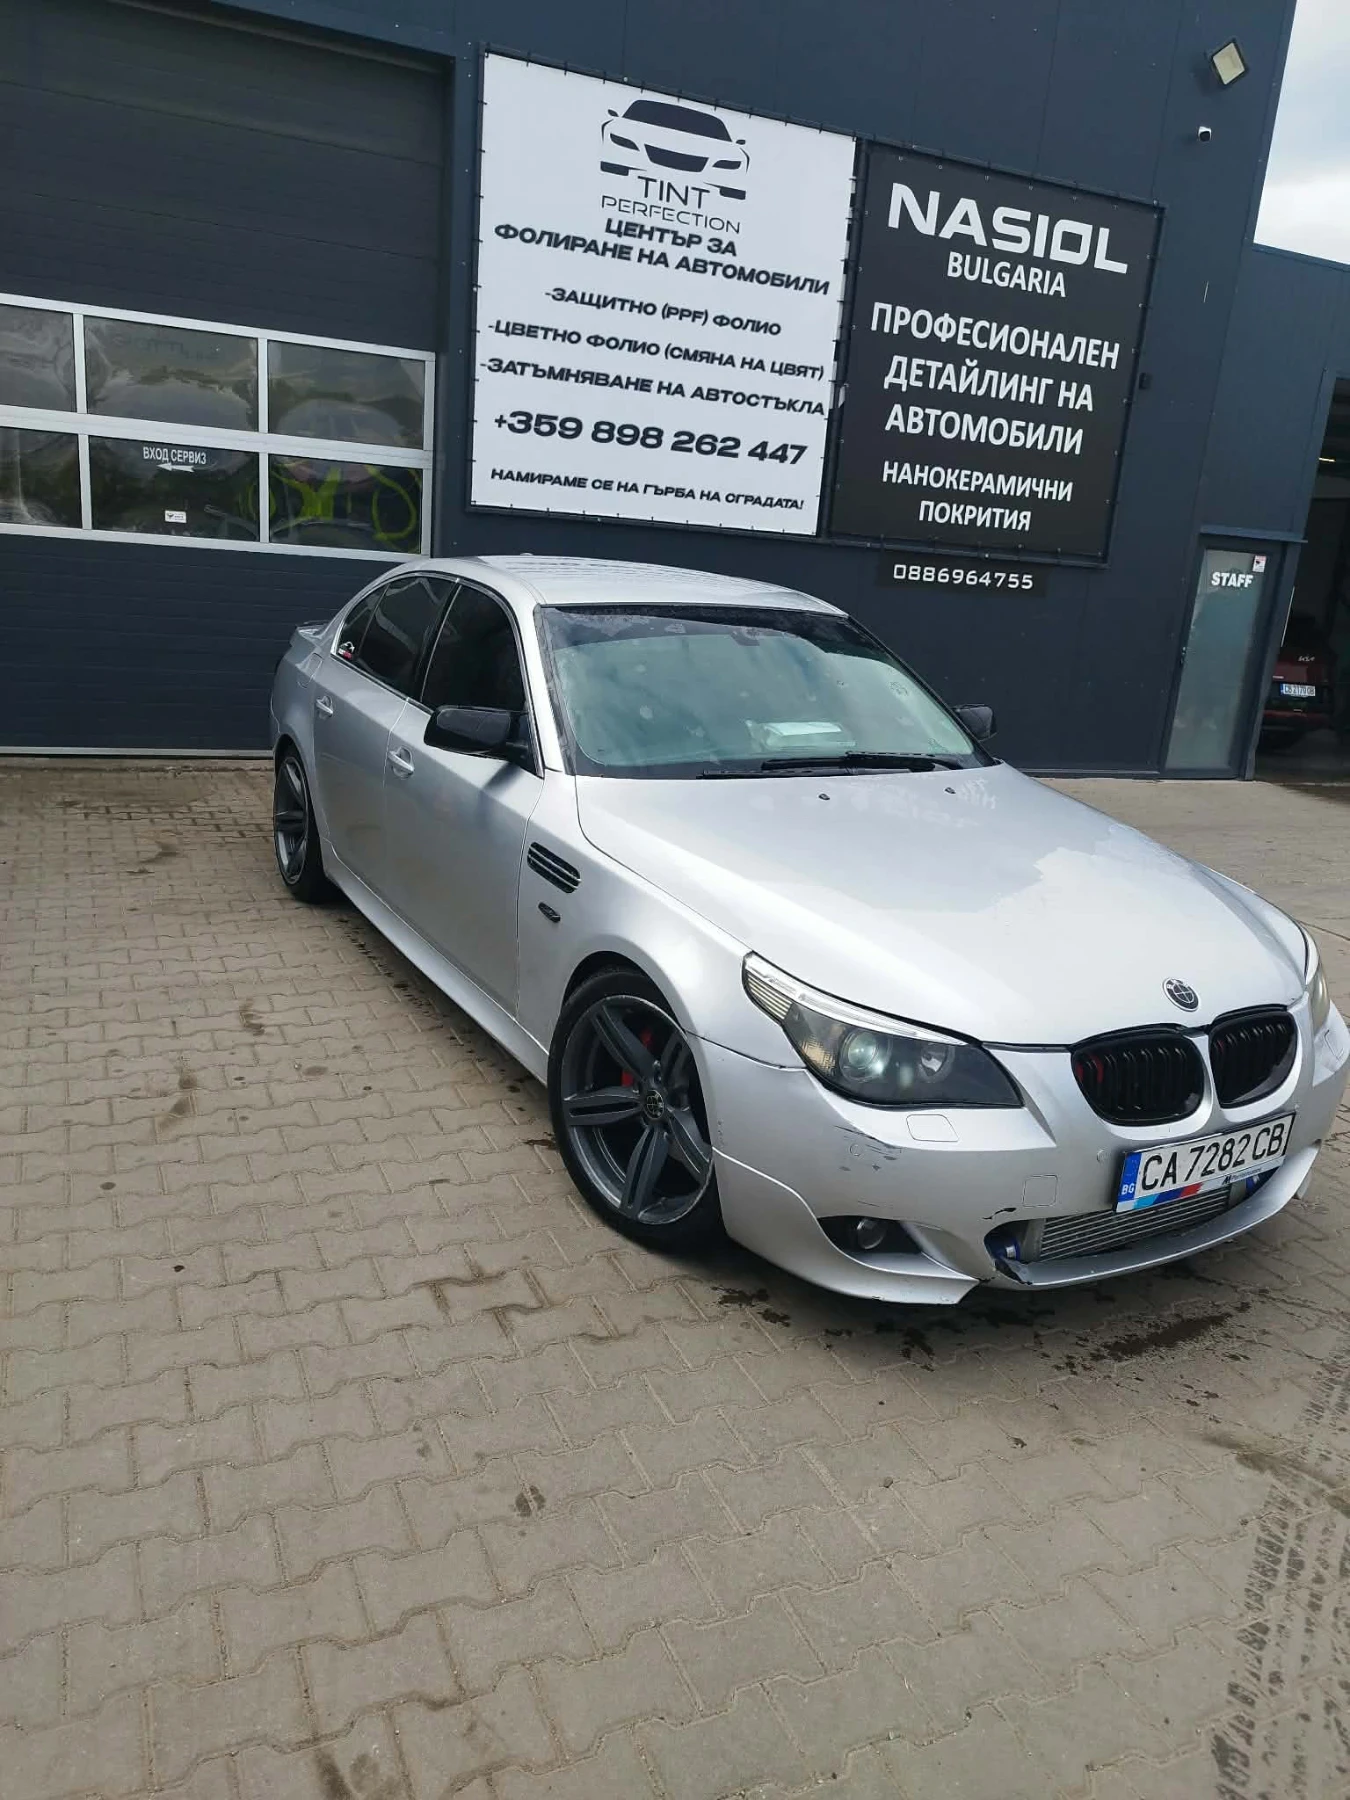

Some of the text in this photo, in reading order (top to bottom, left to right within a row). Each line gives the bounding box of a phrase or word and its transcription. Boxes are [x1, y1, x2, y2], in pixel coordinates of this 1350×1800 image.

[601, 195, 741, 234] PERFECTION
[637, 175, 711, 209] TINT
[605, 218, 737, 257] ЦЕНТЪР ЗА
[887, 182, 1128, 274] NASIOL
[494, 224, 830, 295] ФОЛИРАНЕ НА АВТОМОБИЛИ
[947, 252, 1067, 298] BULGARIA
[545, 287, 782, 336] -ЗАЩИТНО (PPF) ФОЛИО
[488, 320, 825, 382] -ЦВЕТНО ФОЛИО (СМЯНА НА ЦВЯТ)
[870, 301, 1120, 370] ПРОФЕСИОНАЛЕН
[480, 358, 825, 416] -ЗАТЪМНЯВАНЕ НА АВТОСТЪКЛА
[883, 355, 1094, 411] ДЕТАЙЛИНГ НА
[494, 411, 808, 465] +359 898 262 447
[884, 404, 1084, 455] АВТОМОБИЛИ
[143, 446, 207, 465] ВХОД СЕРВИЗ
[490, 468, 804, 510] НАМИРАМЕ СЕ НА ГЪРБА НА ОГРАДАТА!
[882, 460, 1073, 502] НАНОКЕРАМИЧНИ
[918, 500, 1031, 532] ПОКРИТИЯ
[893, 563, 1034, 590] 0886964755
[1211, 572, 1254, 588] STAFF
[1121, 1122, 1285, 1195] BG CA 7282 CB
